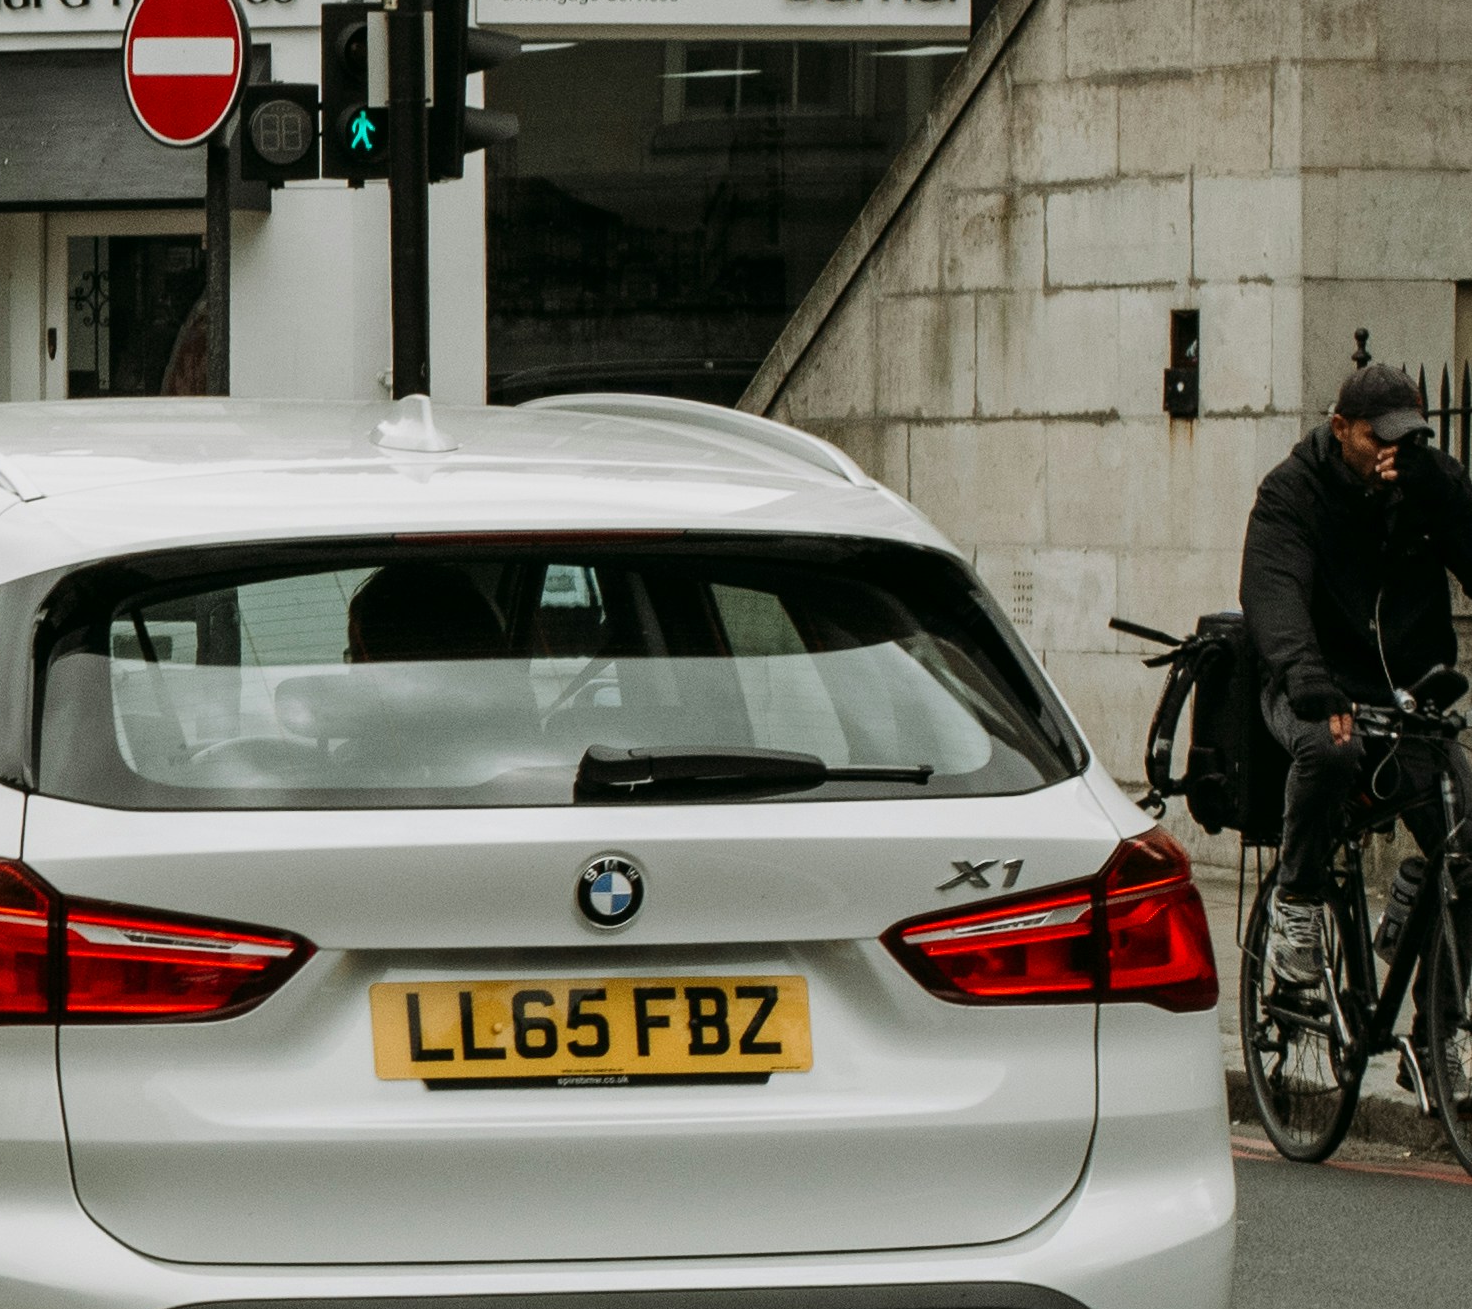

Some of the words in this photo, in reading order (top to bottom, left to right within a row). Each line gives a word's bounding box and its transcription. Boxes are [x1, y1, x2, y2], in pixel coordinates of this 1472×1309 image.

[936, 857, 1025, 891] X1
[406, 987, 610, 1063] LL65
[632, 985, 783, 1057] FBZ
